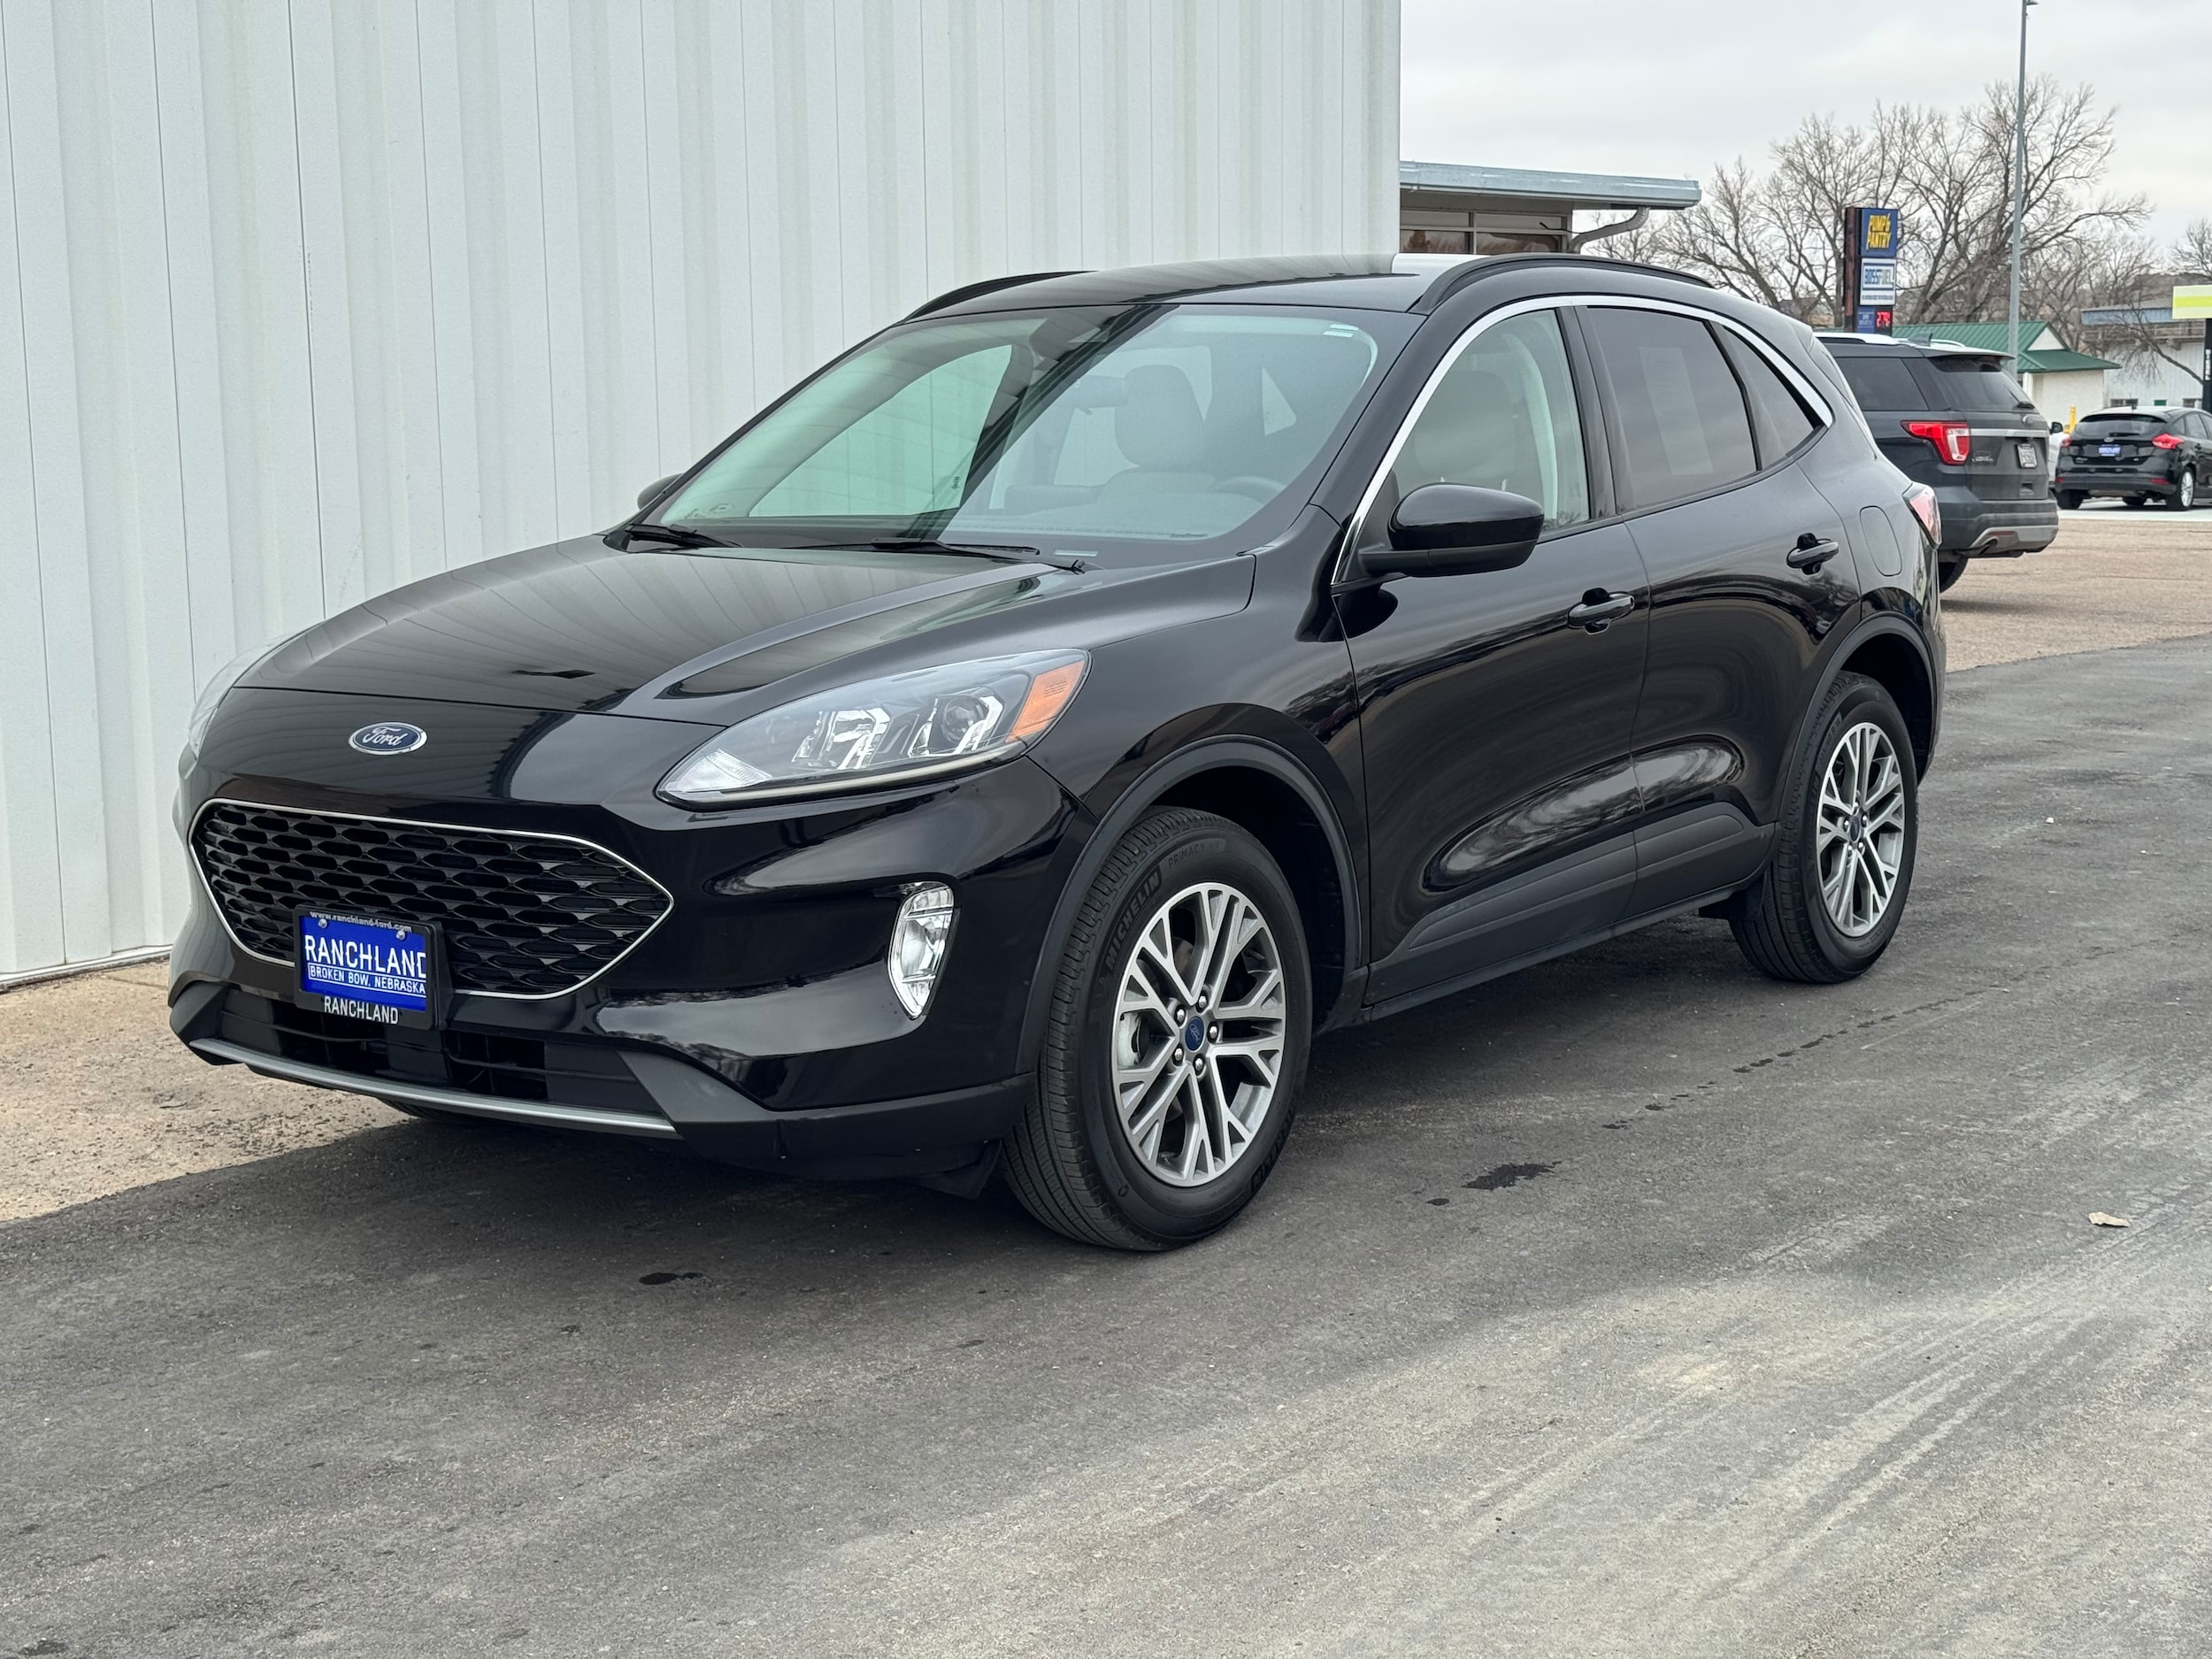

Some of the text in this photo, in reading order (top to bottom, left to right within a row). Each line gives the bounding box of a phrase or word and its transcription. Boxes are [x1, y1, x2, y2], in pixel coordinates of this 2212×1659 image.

[1865, 232, 1892, 250] PANTRY
[362, 726, 409, 746] Ford
[1167, 841, 1205, 869] PRIMACY
[1105, 870, 1160, 972] MICHELIN
[304, 934, 426, 979] RANCHLAND
[310, 965, 345, 982] BROKEN
[374, 978, 426, 995] NEBRASKA
[324, 995, 399, 1025] RANCHLAND
